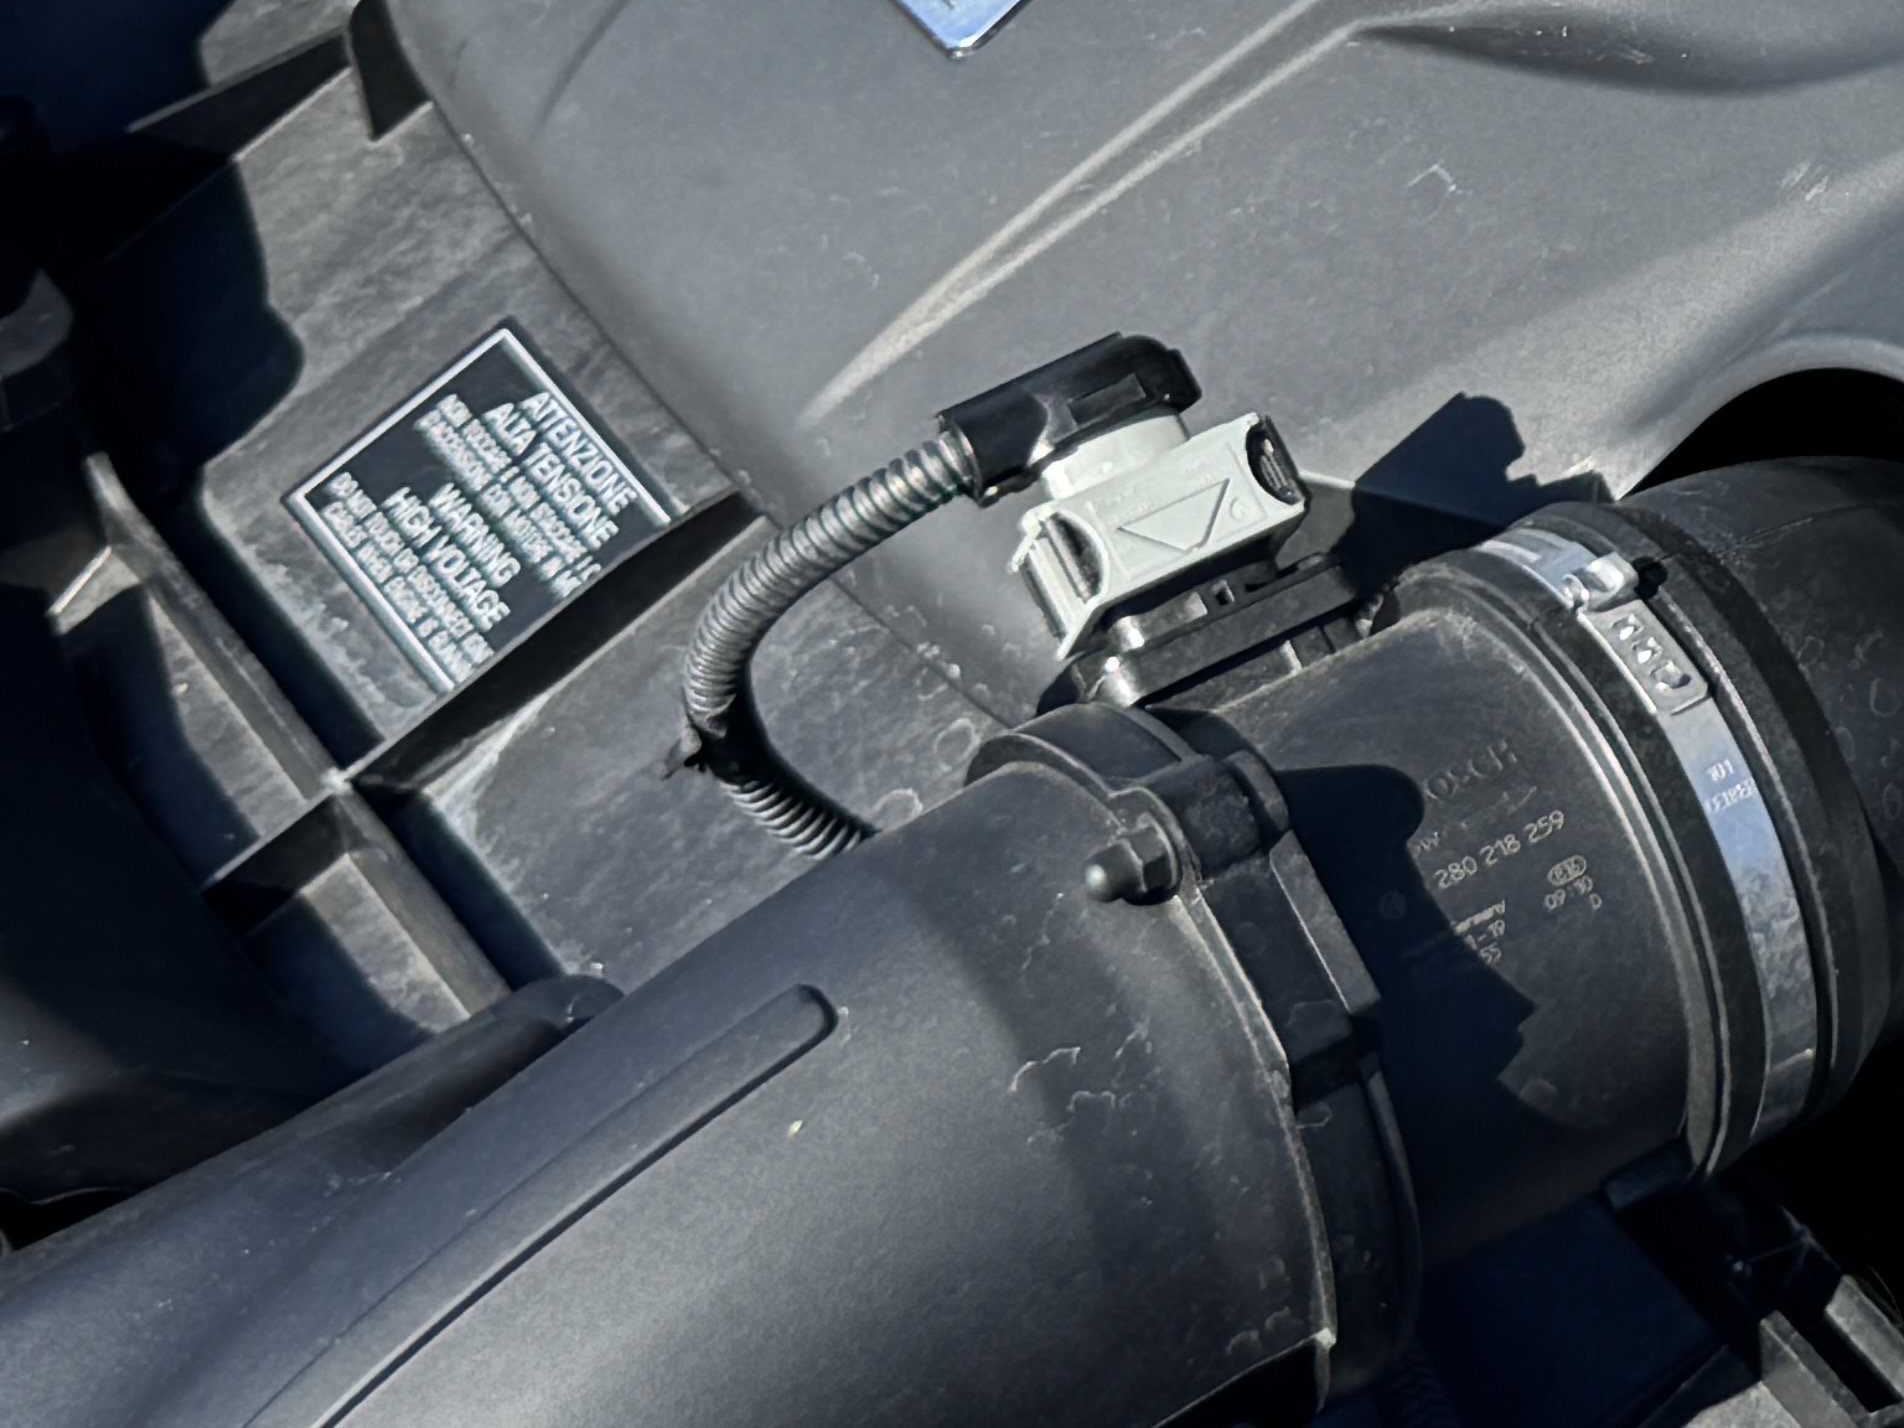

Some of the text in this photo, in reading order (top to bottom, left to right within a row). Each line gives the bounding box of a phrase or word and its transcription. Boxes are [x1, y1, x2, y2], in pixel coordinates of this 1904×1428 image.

[485, 403, 616, 546] ALTA TENSIONE
[524, 393, 634, 512] ATTENZIONE
[385, 488, 508, 628] HIGH VOLTAGE
[431, 484, 519, 584] WARNING
[1435, 855, 1478, 890] 280
[1479, 834, 1521, 867] 218
[1522, 809, 1565, 843] 259
